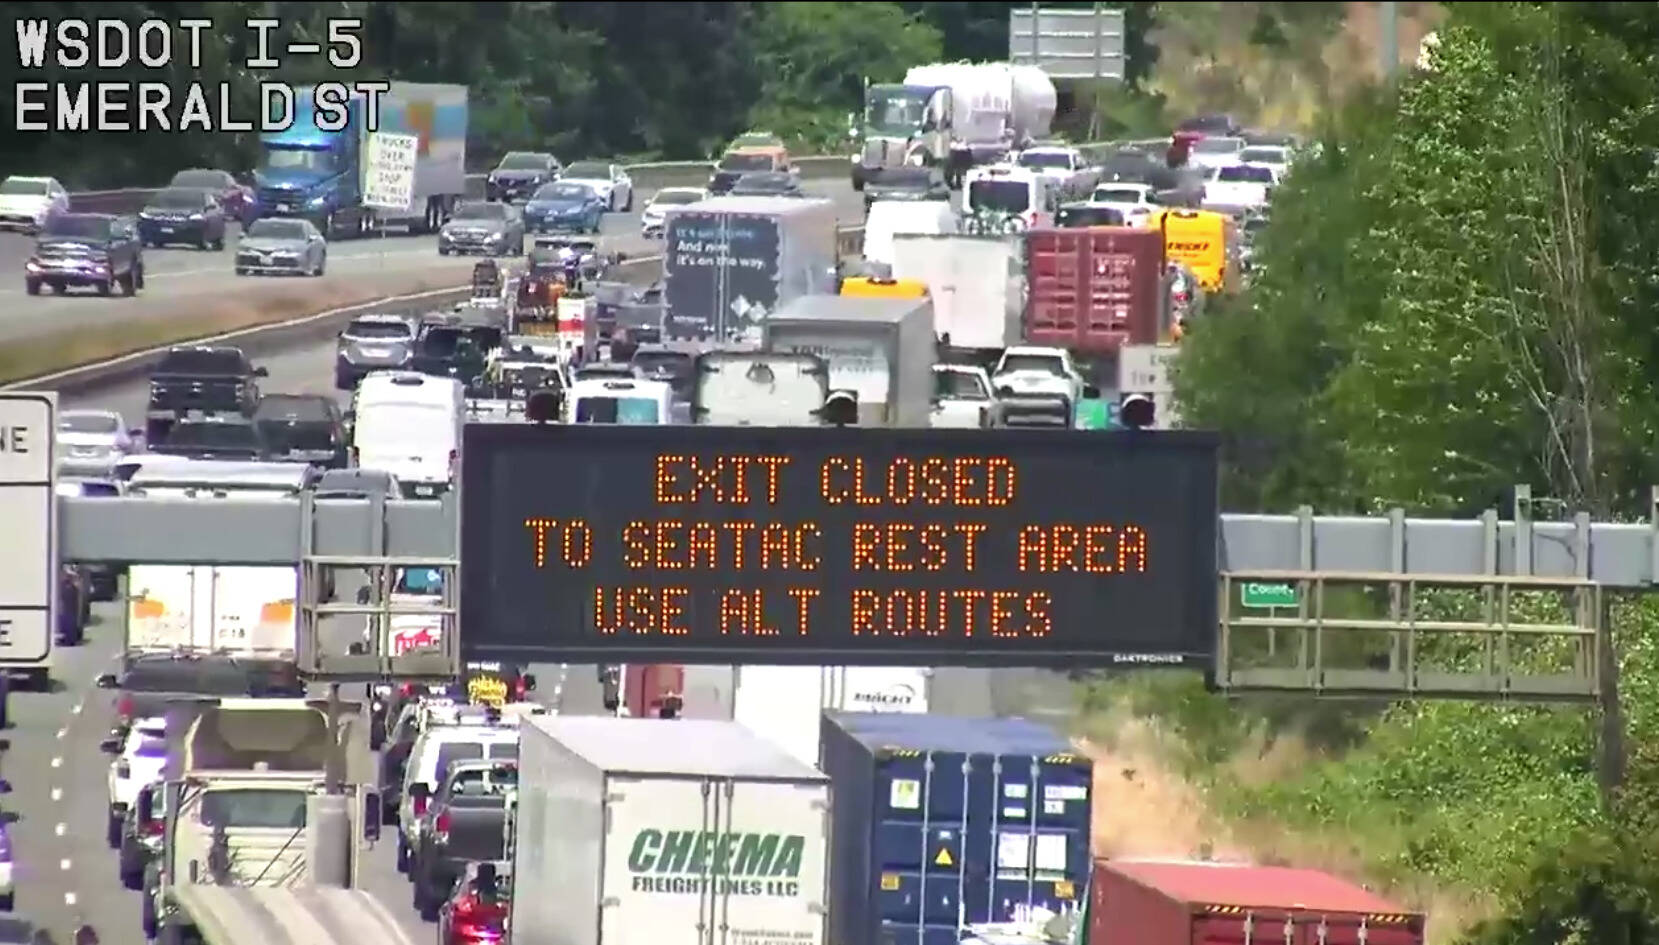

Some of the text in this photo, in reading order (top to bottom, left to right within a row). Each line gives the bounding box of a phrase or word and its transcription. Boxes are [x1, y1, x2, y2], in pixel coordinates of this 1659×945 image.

[677, 240, 702, 252] And
[655, 455, 1016, 507] EXIT CLOSED
[526, 518, 1149, 573] TO SEATAC REST AREA
[594, 586, 1053, 638] USE ALT ROUTES
[628, 828, 806, 878] CHEEMA
[767, 880, 799, 897] LLC
